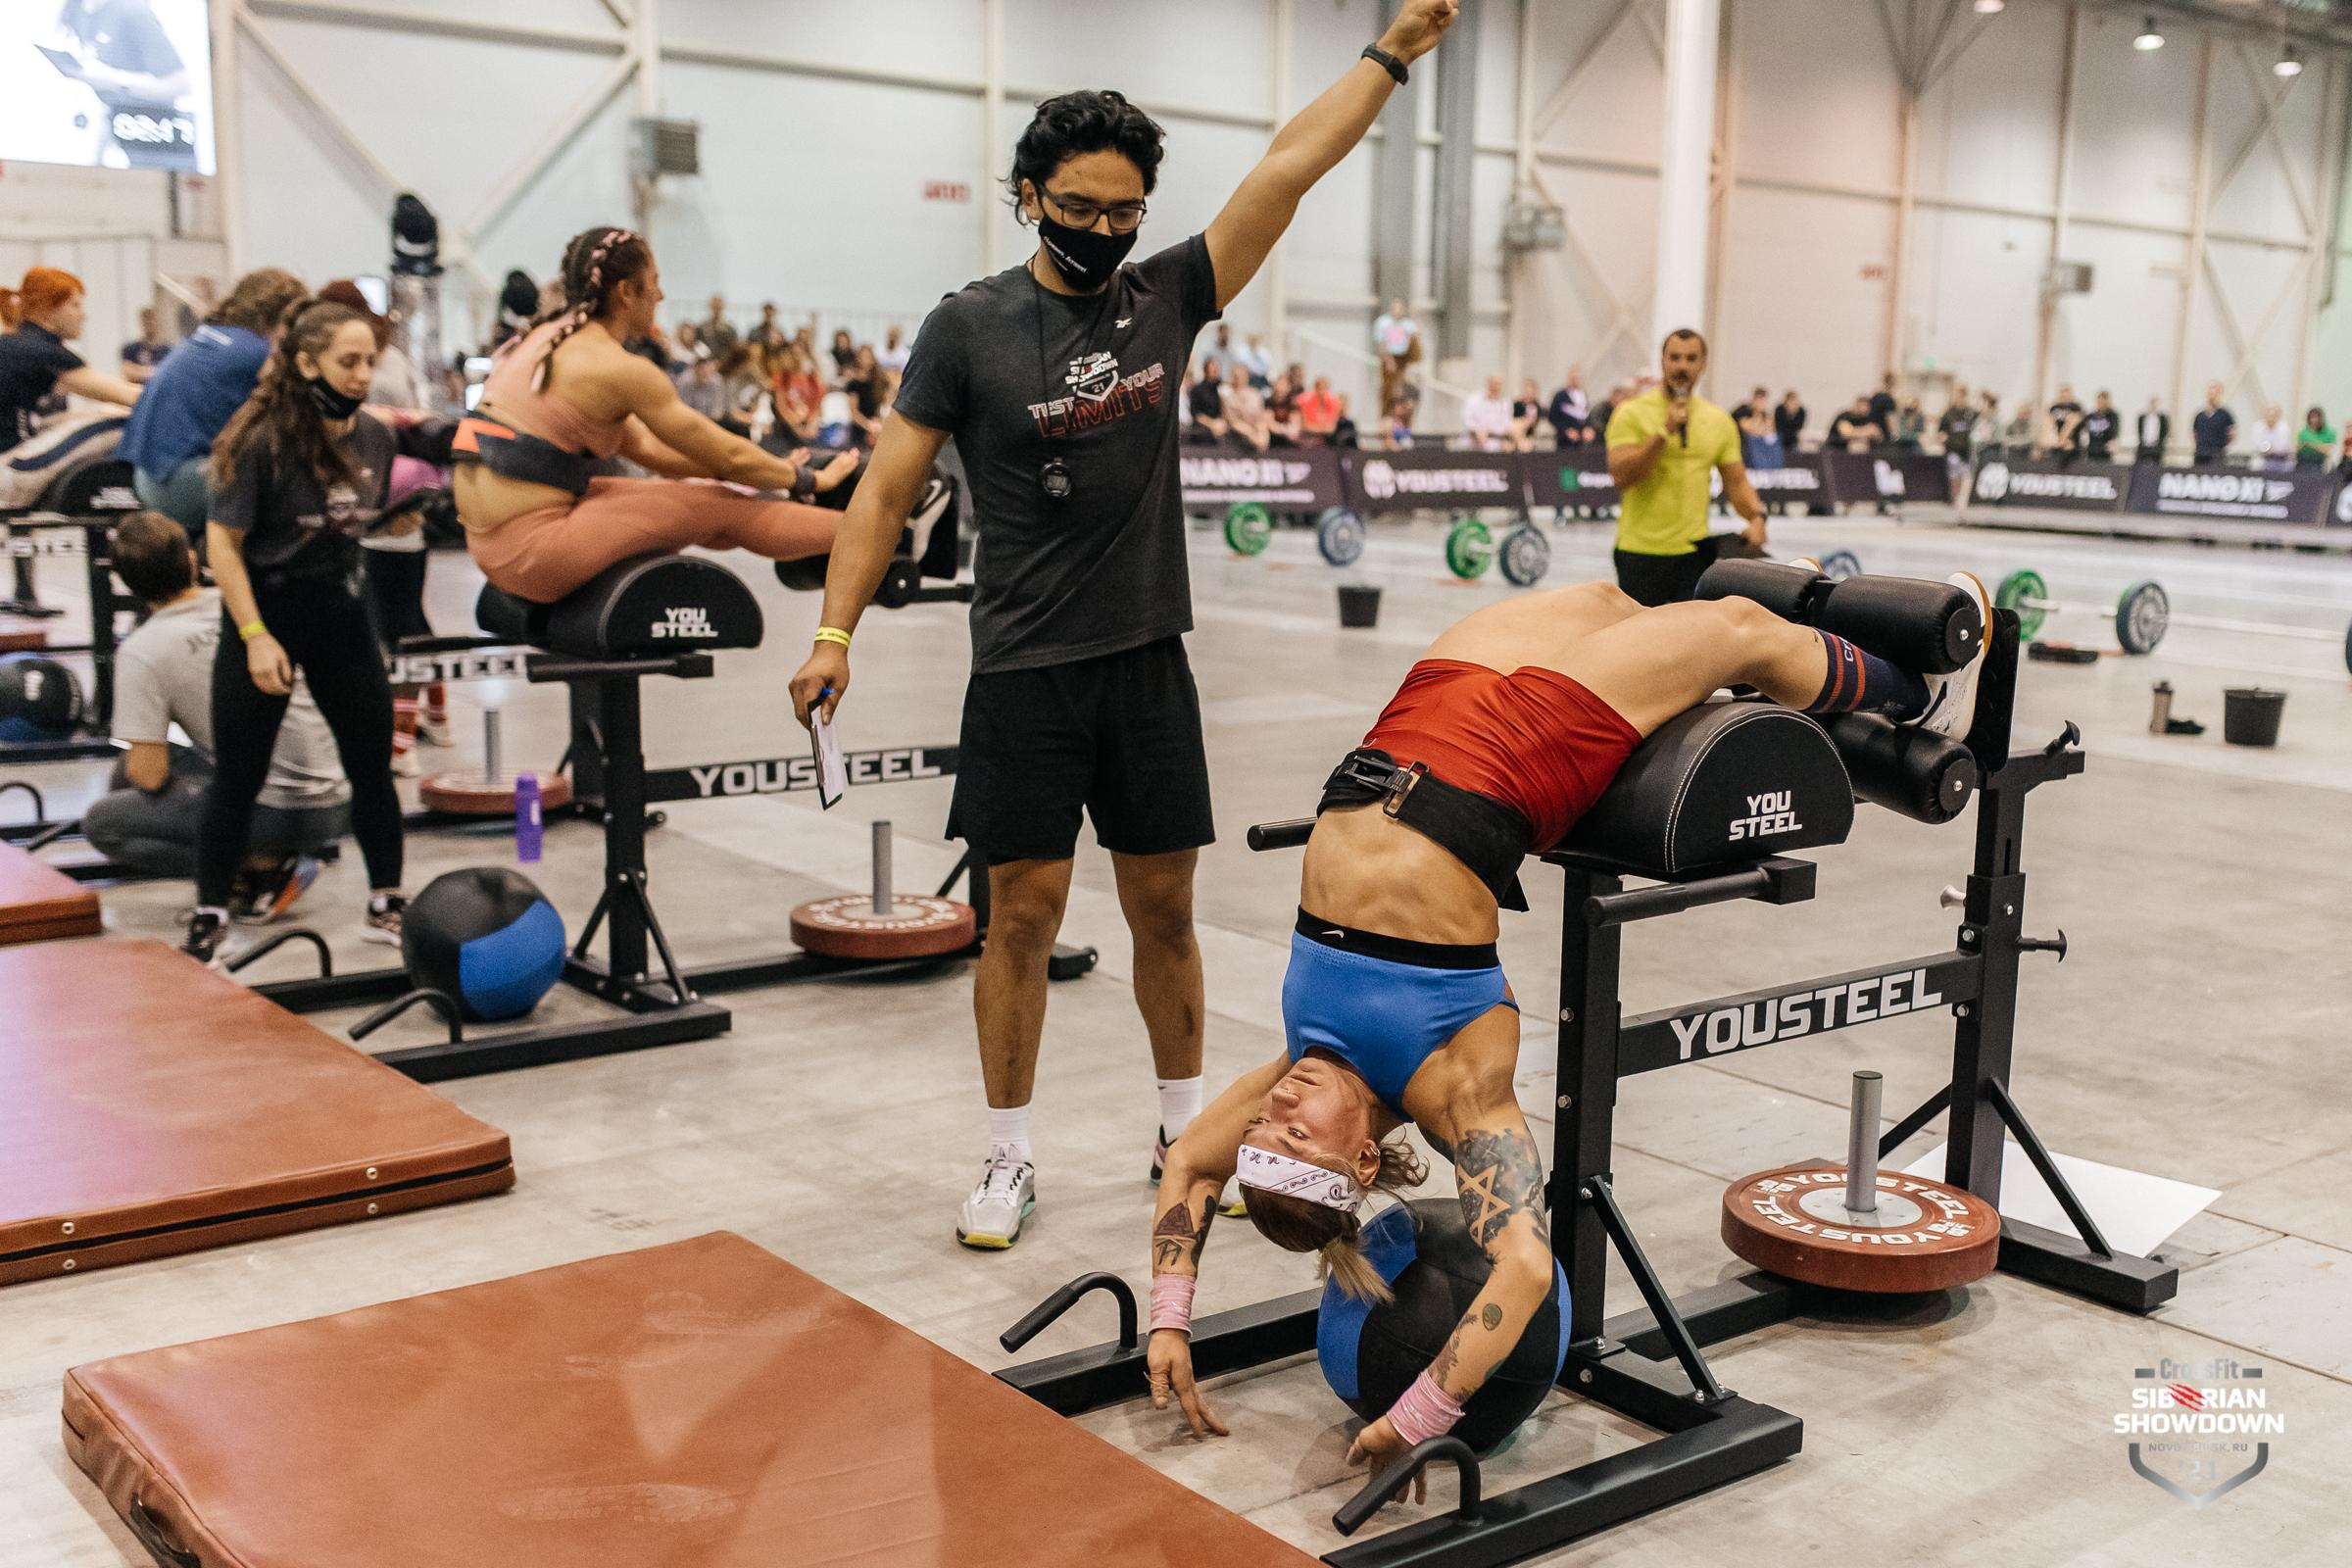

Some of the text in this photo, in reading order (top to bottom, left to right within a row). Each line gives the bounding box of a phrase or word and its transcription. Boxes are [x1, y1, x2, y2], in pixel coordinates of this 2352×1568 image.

[1120, 363, 1165, 391] YOUR
[651, 621, 718, 638] STEEL
[664, 607, 707, 623] YOU
[690, 749, 941, 797] YOUSEEL
[1746, 790, 1791, 815] YOU
[1728, 811, 1802, 841] STEEL
[1669, 968, 1941, 1060] YOUSTEEL
[1785, 1173, 1969, 1219] YOSTEEL
